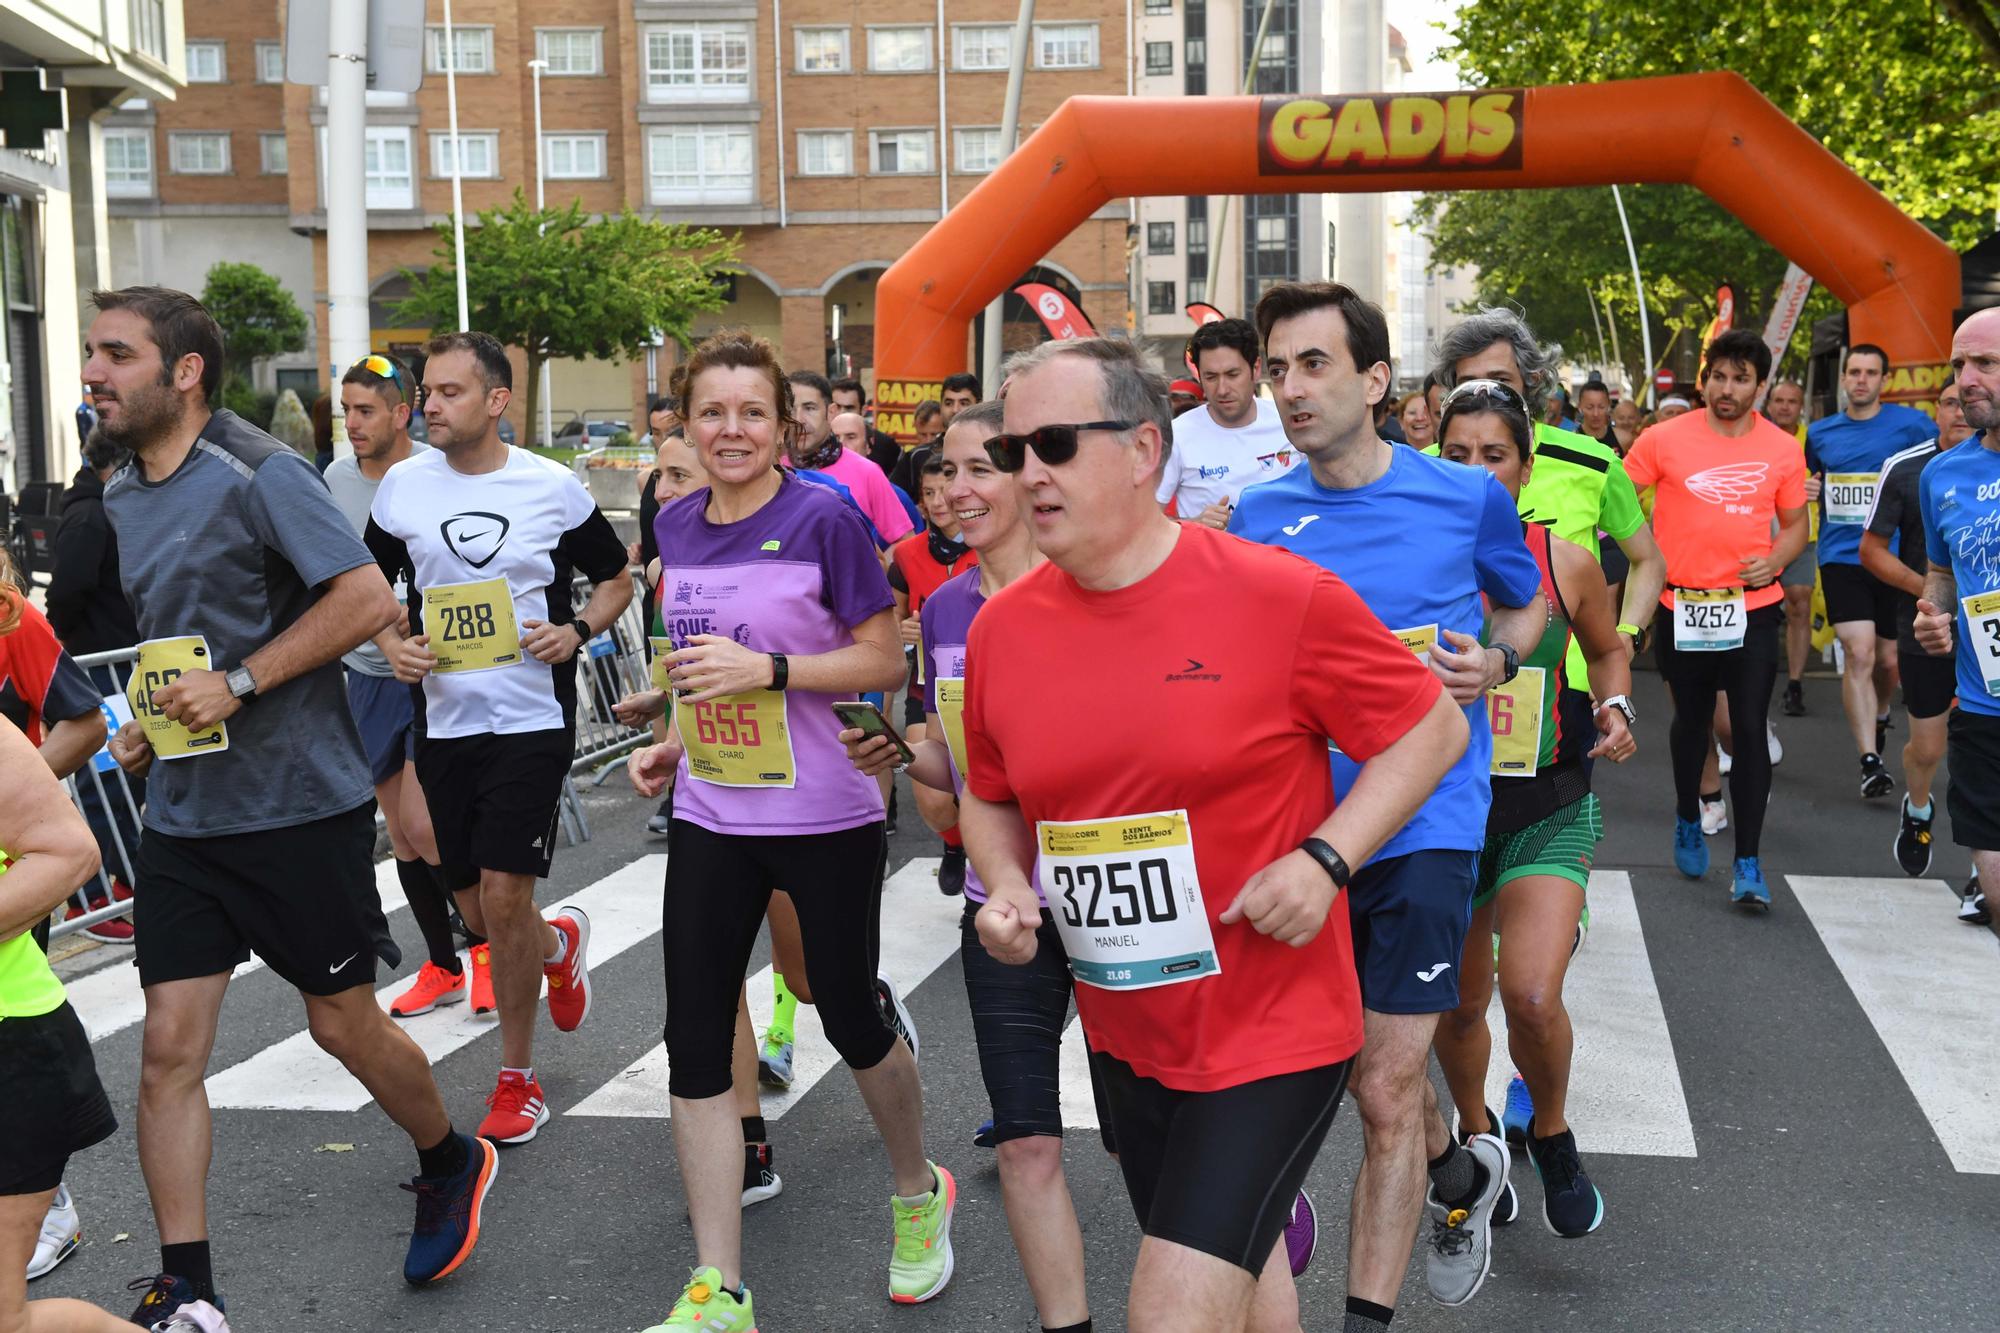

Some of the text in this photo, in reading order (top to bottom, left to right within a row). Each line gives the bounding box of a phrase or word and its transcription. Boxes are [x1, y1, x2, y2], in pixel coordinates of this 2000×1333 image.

[1268, 94, 1515, 167] GADIS
[1832, 486, 1874, 505] 3009
[440, 603, 496, 642] 288
[1685, 604, 1737, 629] 3252
[456, 641, 484, 651] MARCOS
[149, 720, 172, 731] DIEGO
[694, 701, 761, 747] 655
[718, 750, 745, 760] CHARO
[1123, 829, 1173, 841] DOS BARRIOS
[1128, 825, 1152, 834] XENTE
[1053, 858, 1178, 928] 3250
[1094, 934, 1140, 948] MANUEL
[1106, 969, 1132, 981] 21.05
